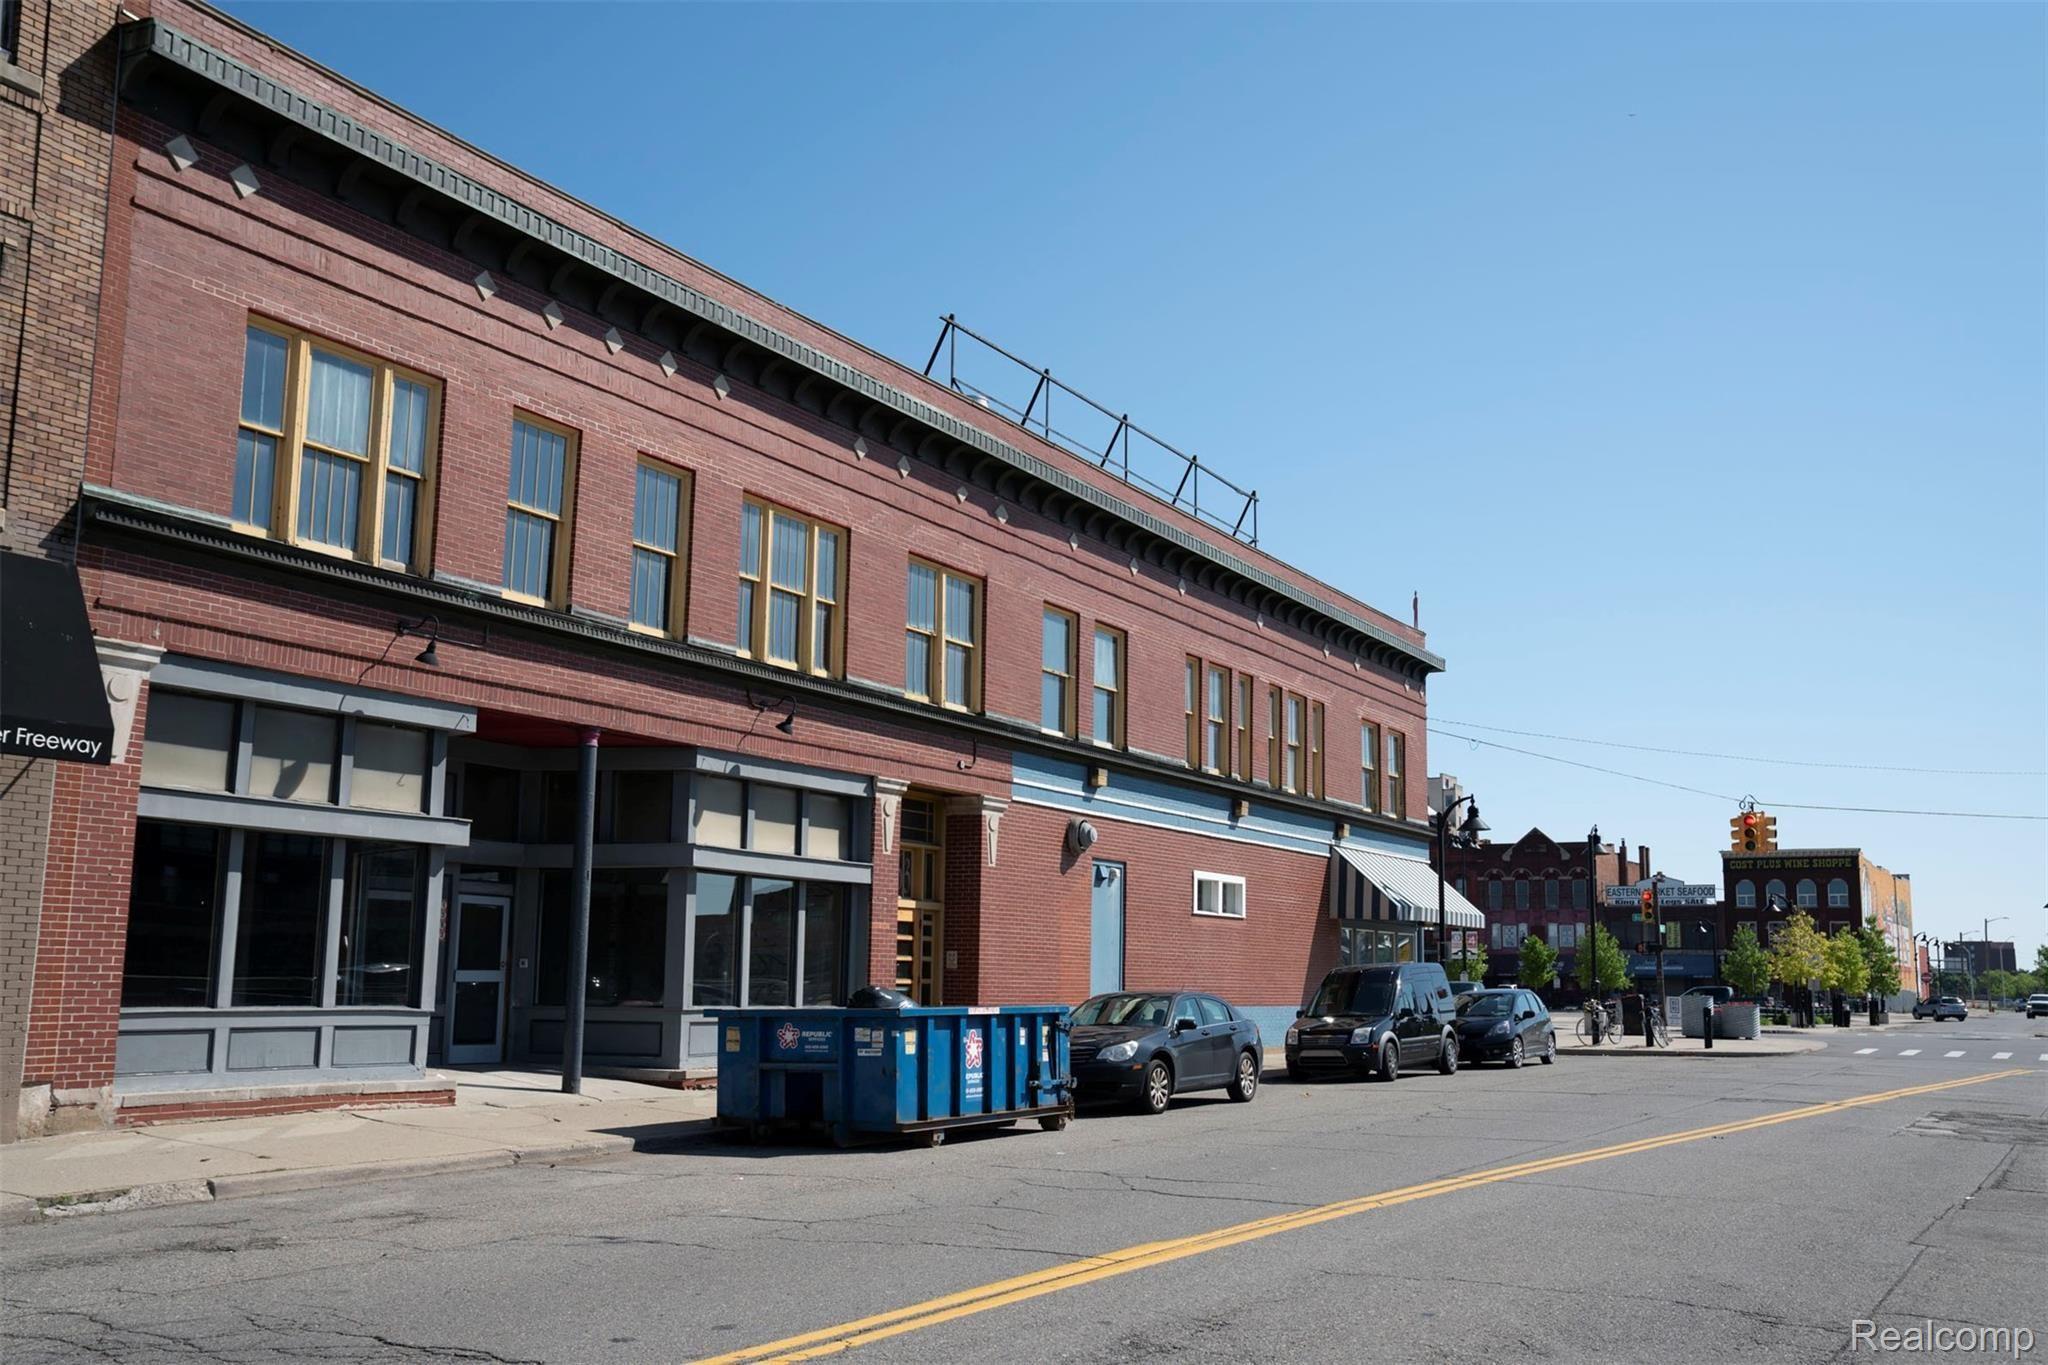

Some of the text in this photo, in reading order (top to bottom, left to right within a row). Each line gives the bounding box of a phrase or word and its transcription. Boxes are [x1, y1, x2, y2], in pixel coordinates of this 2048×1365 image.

[0, 727, 102, 758] r Freeway
[1729, 858, 1852, 869] COST PLUS WINE SHOPPE
[1607, 887, 1641, 897] EASTERN
[1677, 886, 1715, 896] SEAFOOD
[801, 1030, 832, 1038] REPUBLIC
